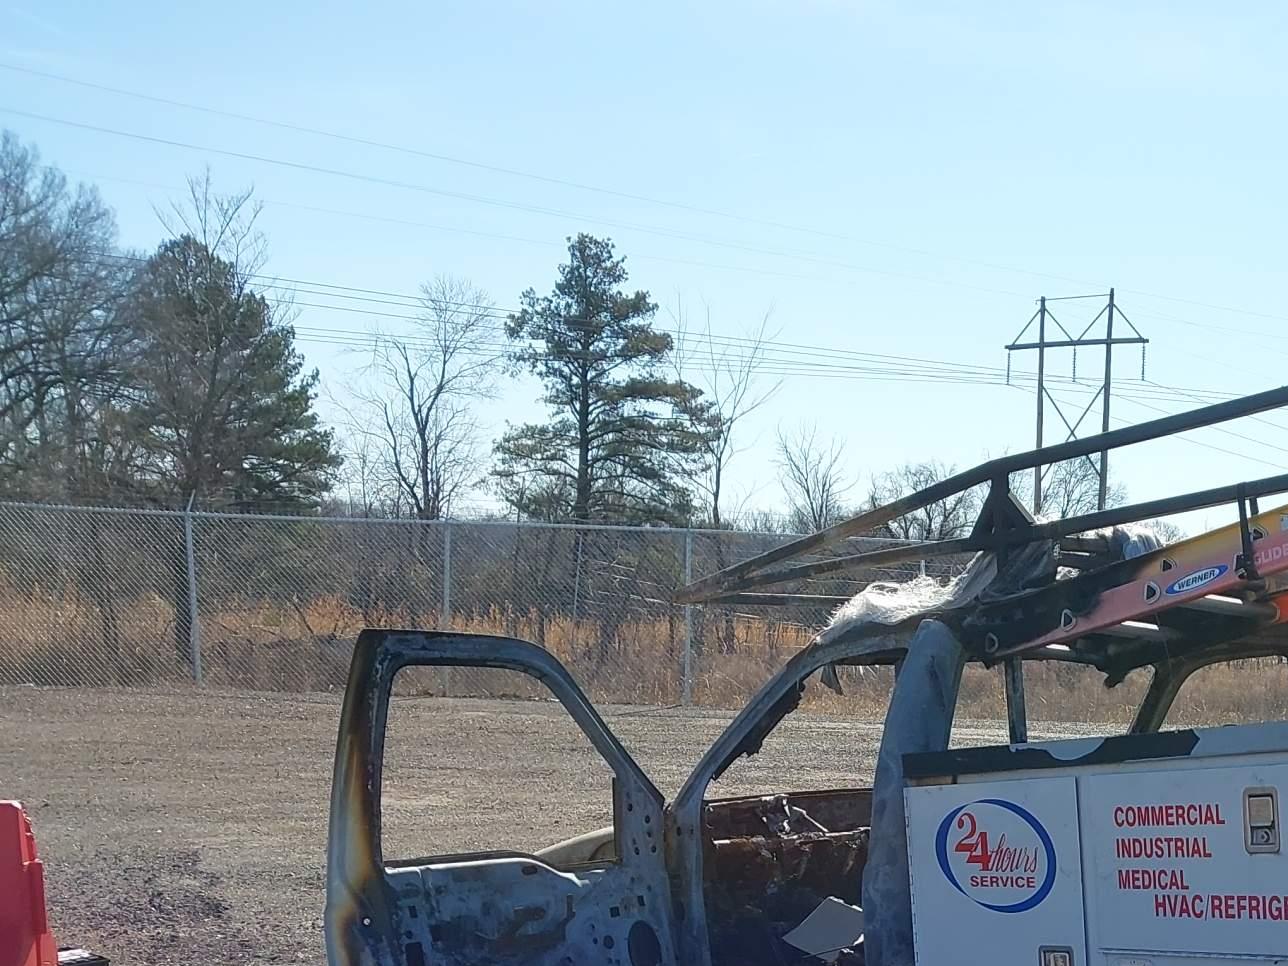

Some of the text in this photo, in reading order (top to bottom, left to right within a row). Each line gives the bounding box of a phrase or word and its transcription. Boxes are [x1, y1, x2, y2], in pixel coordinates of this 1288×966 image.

[1177, 568, 1217, 591] WERNER
[1113, 803, 1226, 828] COMMERCIAL
[954, 811, 1039, 873] 24 hours
[1115, 836, 1213, 859] INDUSTRIAL
[969, 875, 1037, 889] SERVICE
[1117, 868, 1190, 890] MEDICAL
